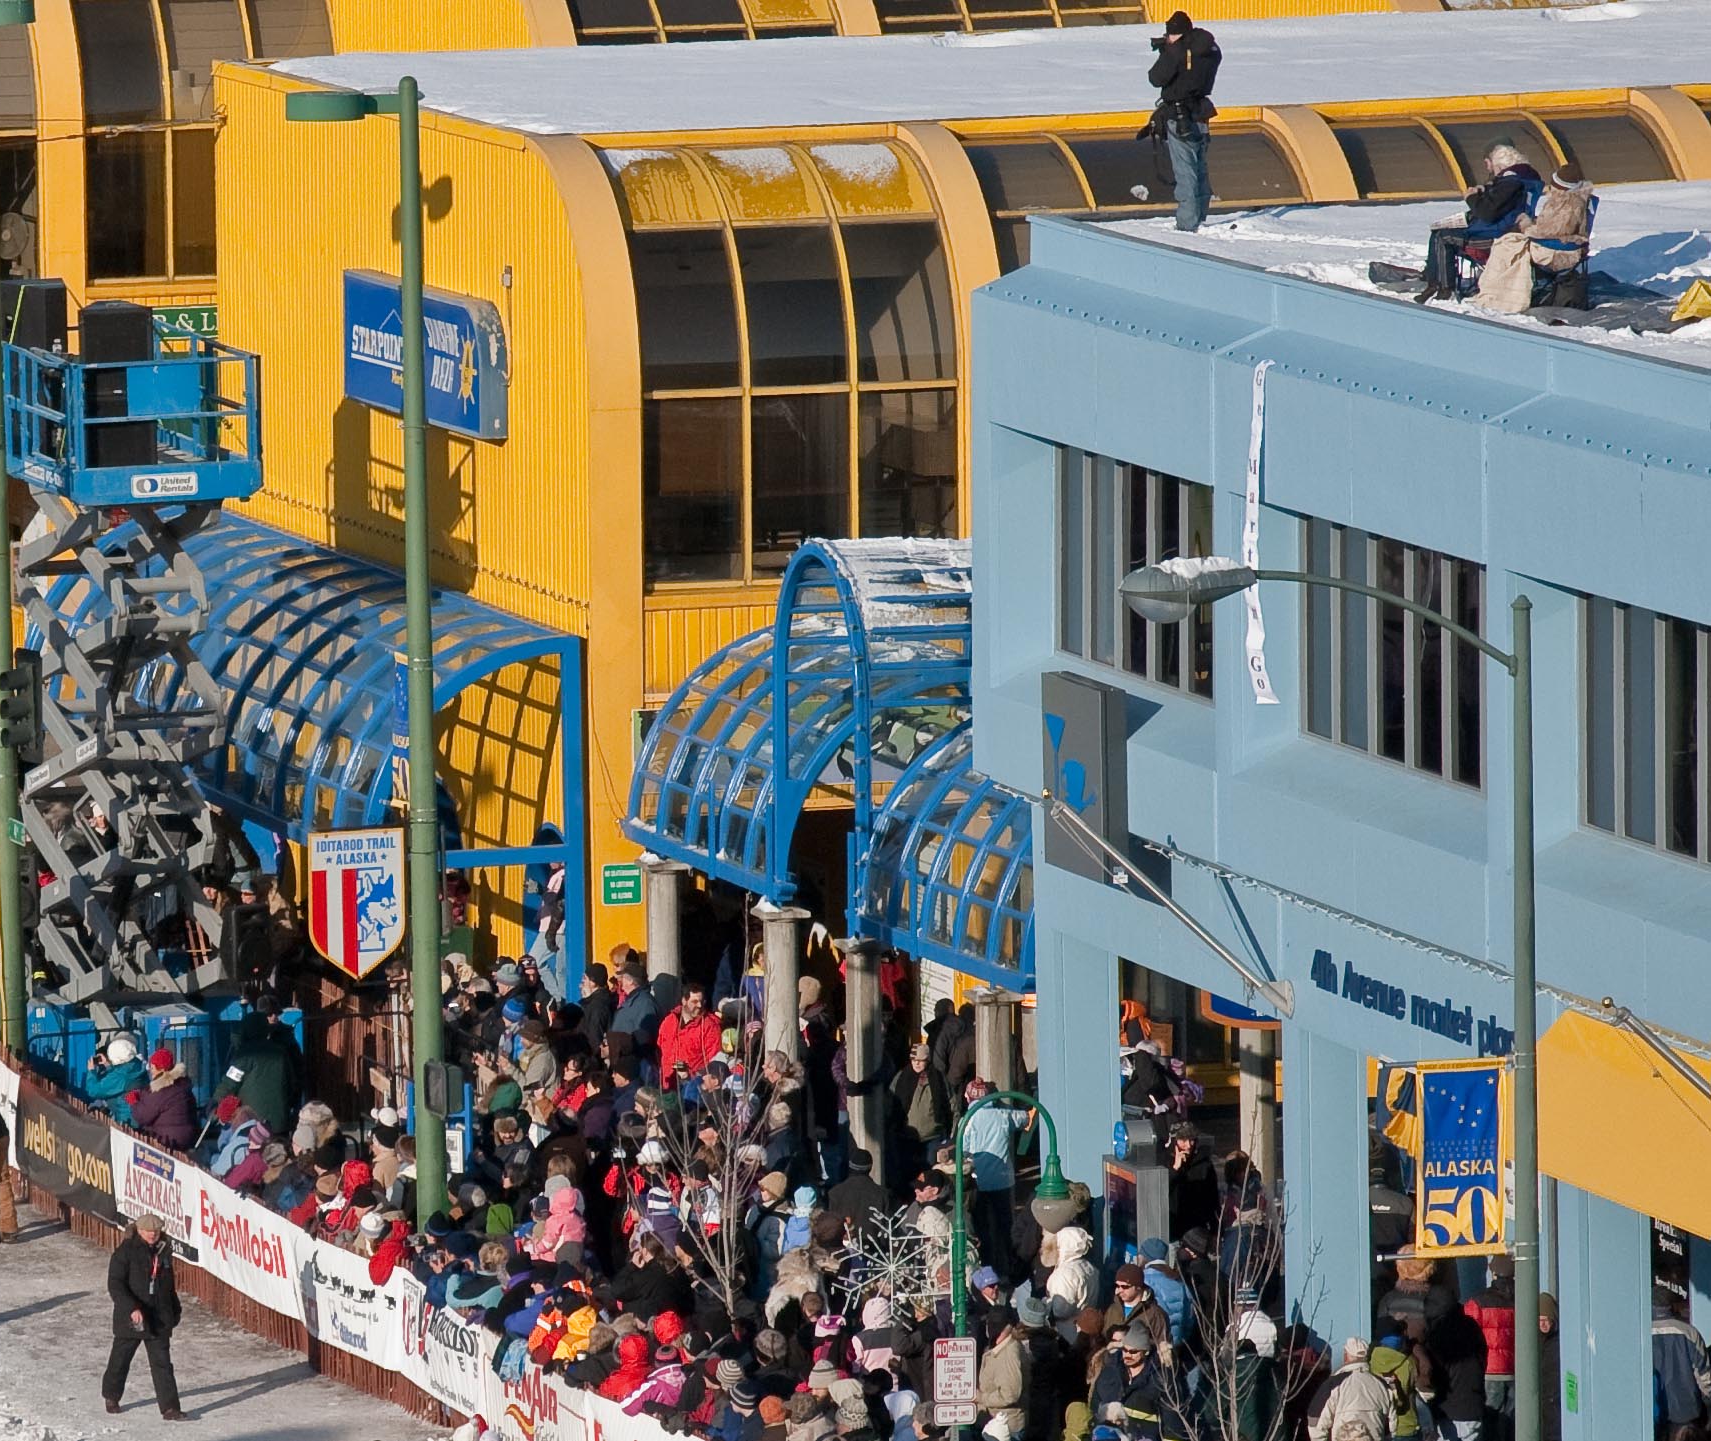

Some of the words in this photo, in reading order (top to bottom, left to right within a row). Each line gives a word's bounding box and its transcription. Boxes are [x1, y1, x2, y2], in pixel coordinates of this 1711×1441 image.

[160, 476, 191, 486] United
[160, 484, 194, 493] Rentals
[316, 839, 364, 853] IDITAROD
[366, 836, 397, 850] TRAIL
[335, 851, 378, 866] ALASKA
[1310, 948, 1338, 995] 4th
[1341, 960, 1406, 1021] Avenue
[1410, 994, 1474, 1046] market
[1424, 1159, 1496, 1178] ALASKA
[124, 1157, 184, 1221] ANCHORAGE
[1423, 1186, 1499, 1247] 50
[200, 1189, 288, 1279] ExxonMobil
[1659, 1233, 1683, 1256] Special
[936, 1341, 948, 1356] NO
[948, 1344, 973, 1353] PARKING
[943, 1366, 967, 1374] LOADING
